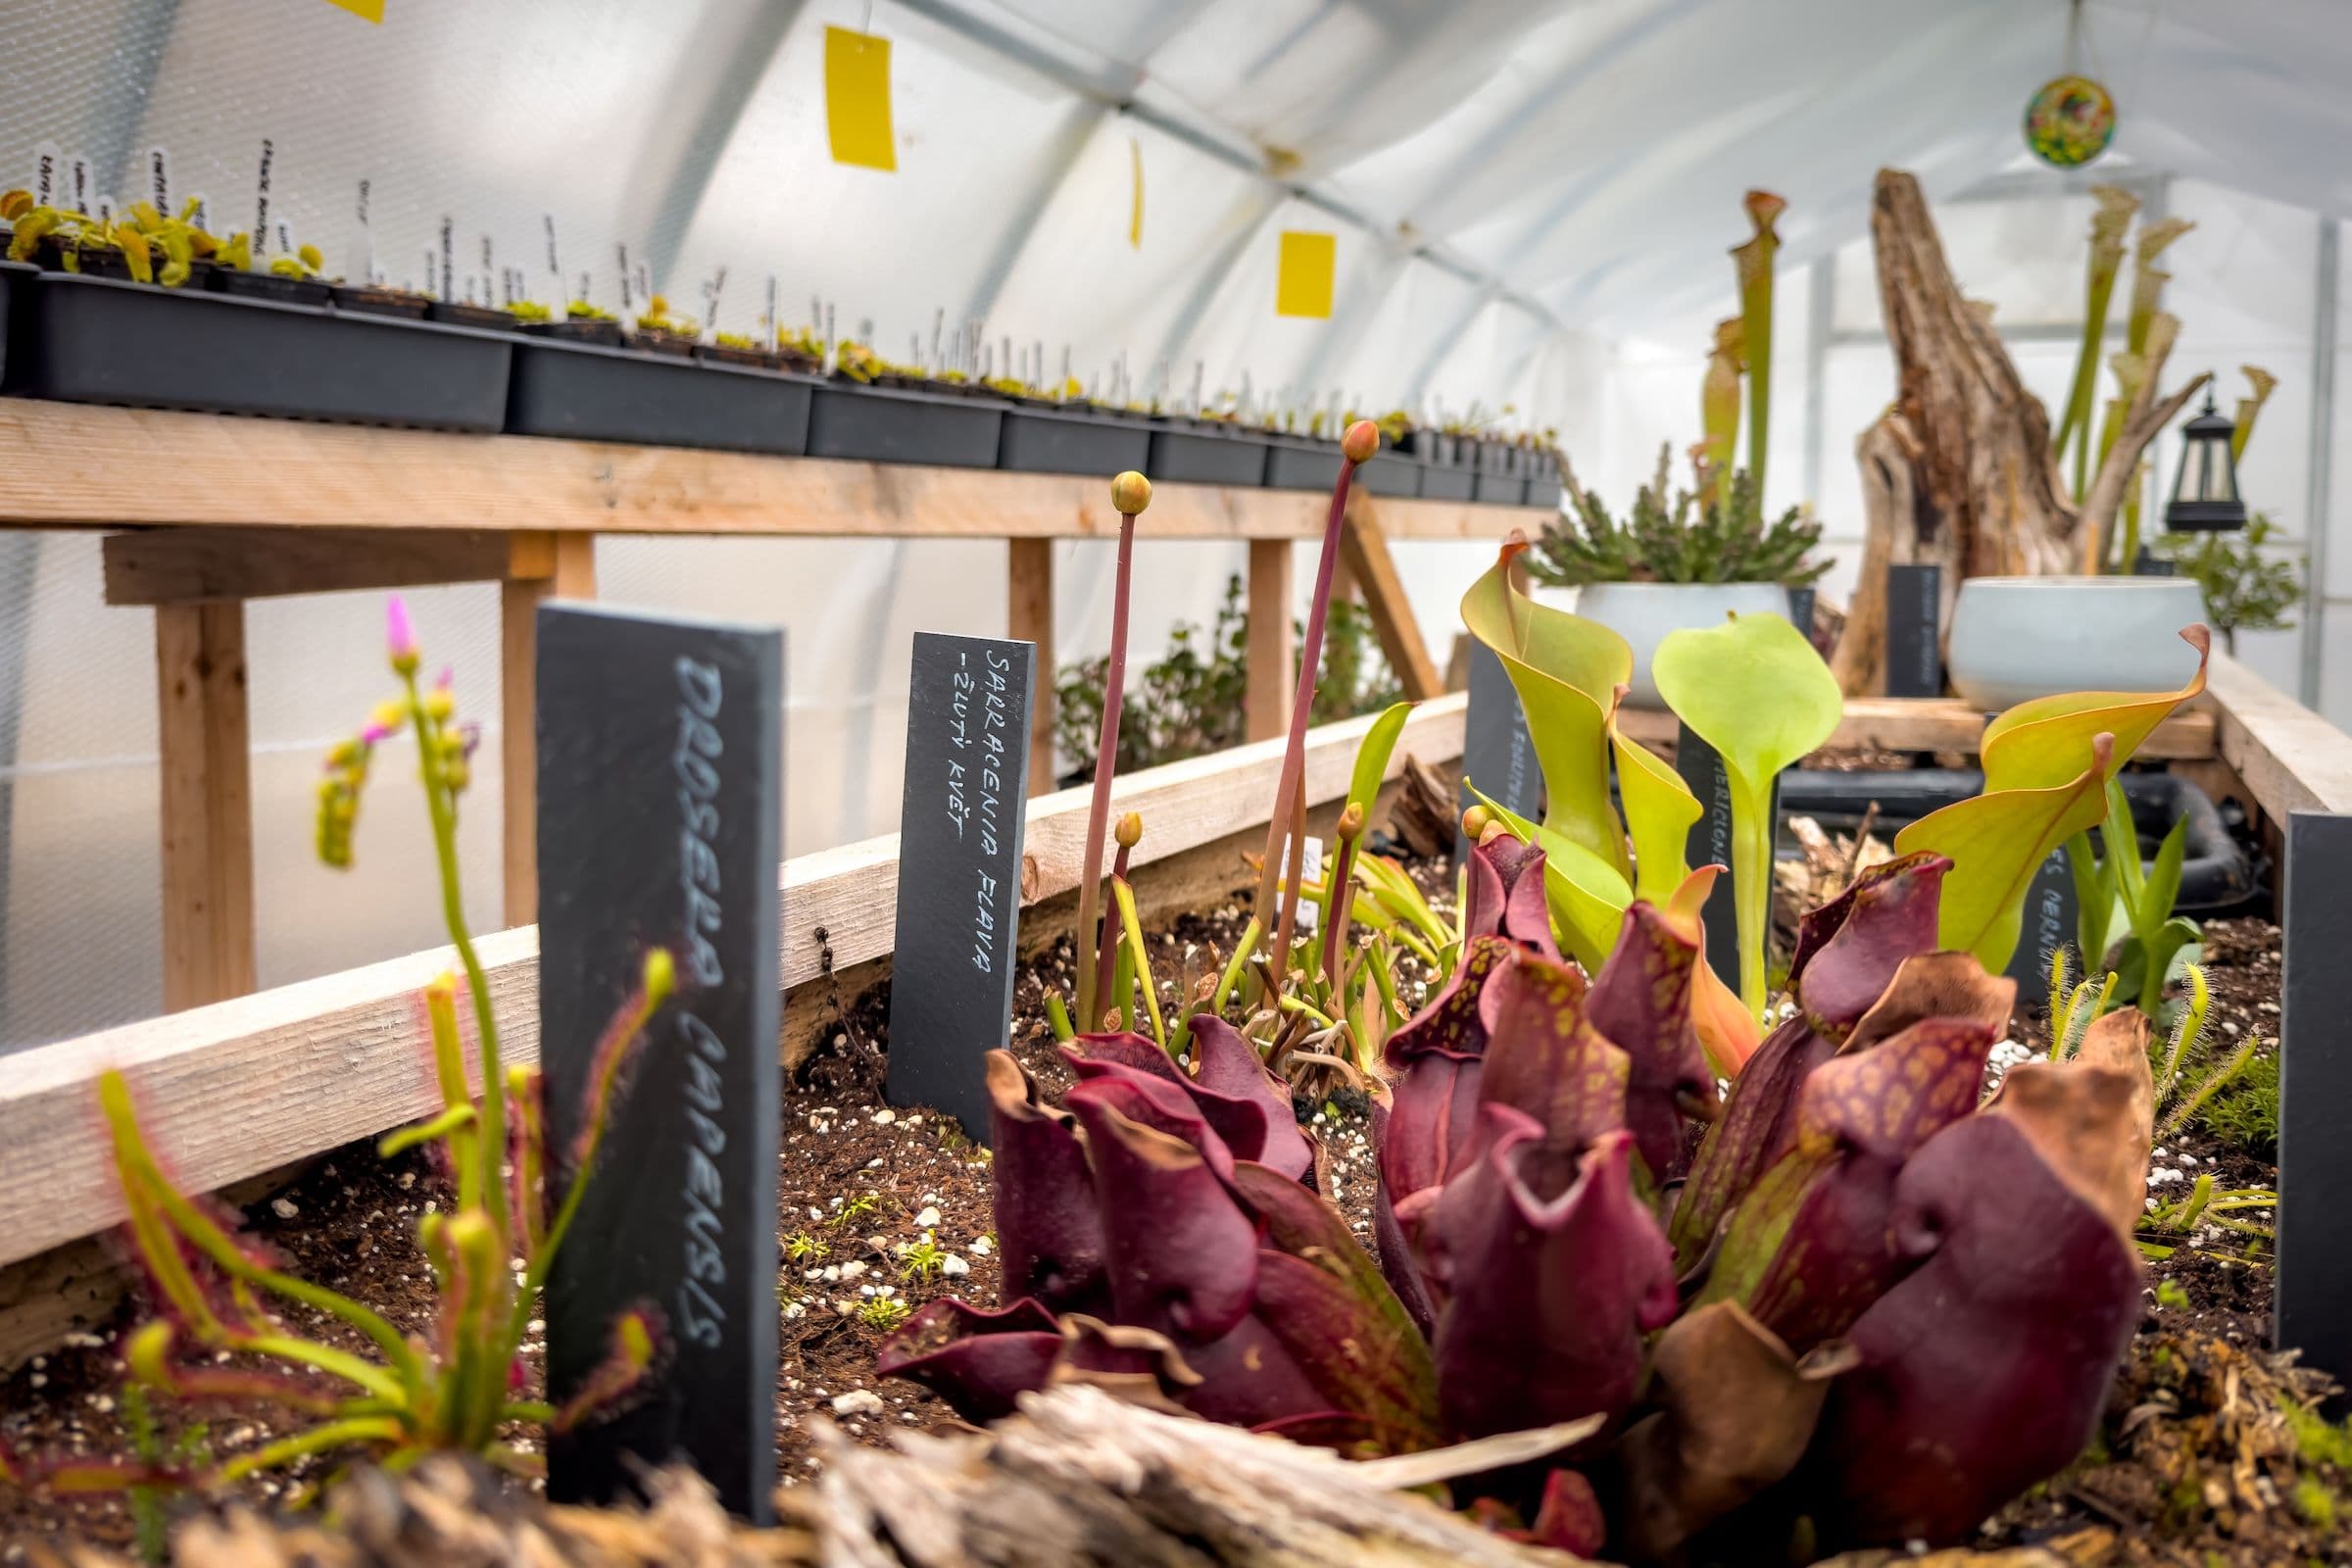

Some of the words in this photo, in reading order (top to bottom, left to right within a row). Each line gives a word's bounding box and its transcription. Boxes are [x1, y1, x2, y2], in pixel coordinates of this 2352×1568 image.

[670, 656, 725, 986] DROSERA
[946, 759, 972, 845] KVĚT
[978, 649, 1010, 858] SARRACENIA
[971, 869, 998, 975] FLAVA
[677, 1010, 728, 1349] CAPENSIS
